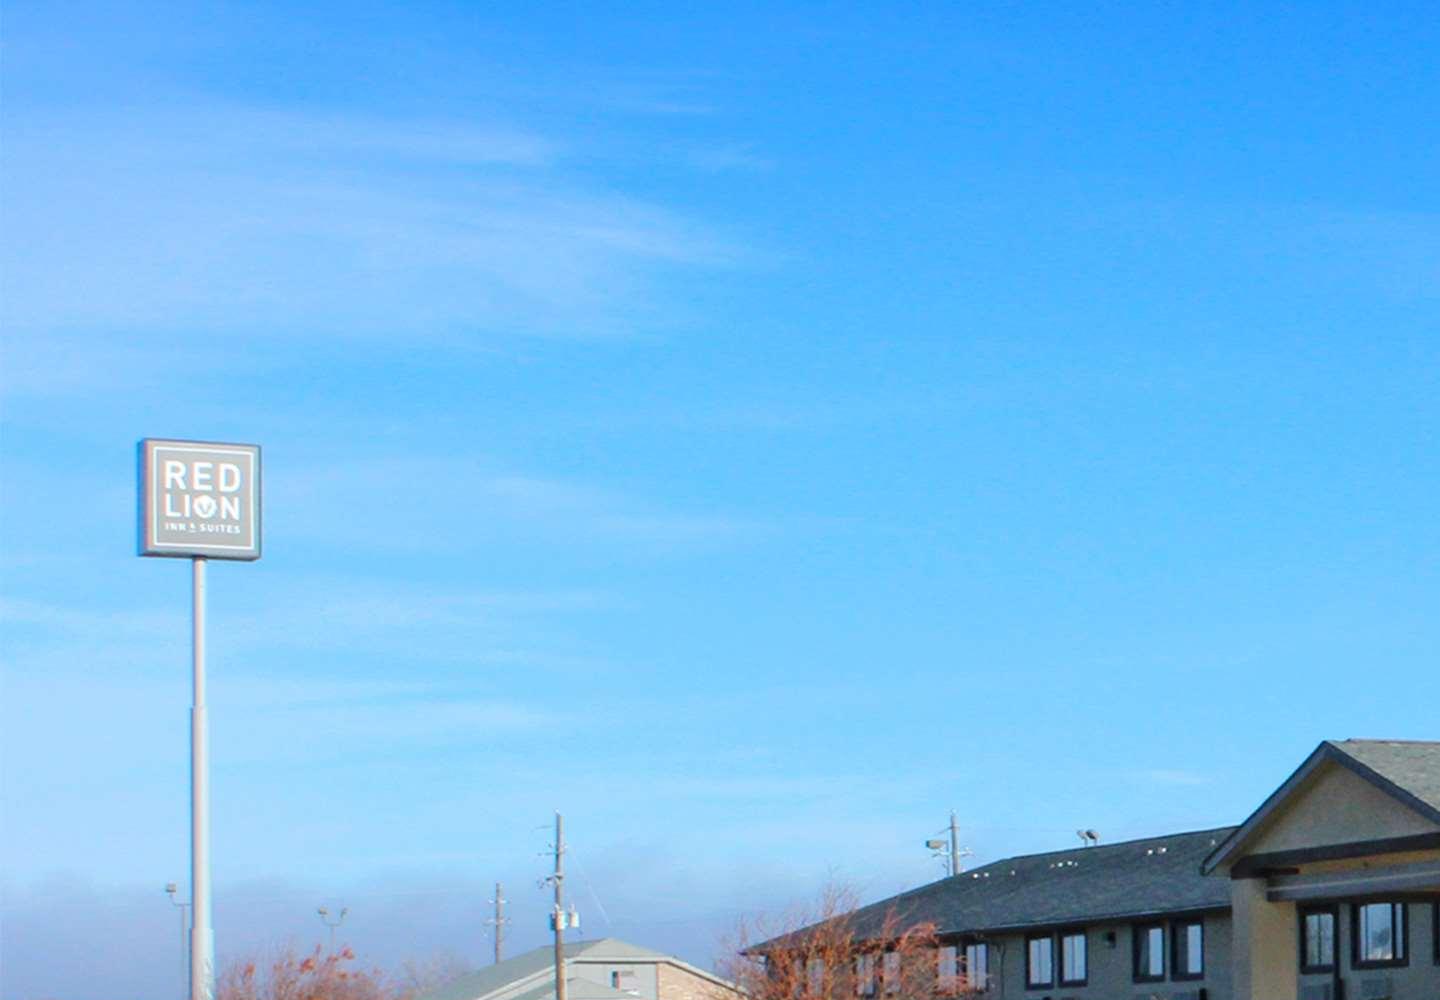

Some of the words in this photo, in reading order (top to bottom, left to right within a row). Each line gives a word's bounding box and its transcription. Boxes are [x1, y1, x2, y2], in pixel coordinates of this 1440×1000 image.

[165, 460, 240, 492] RED
[165, 493, 240, 520] LION
[165, 522, 186, 531] INN
[200, 523, 240, 534] SUITES
